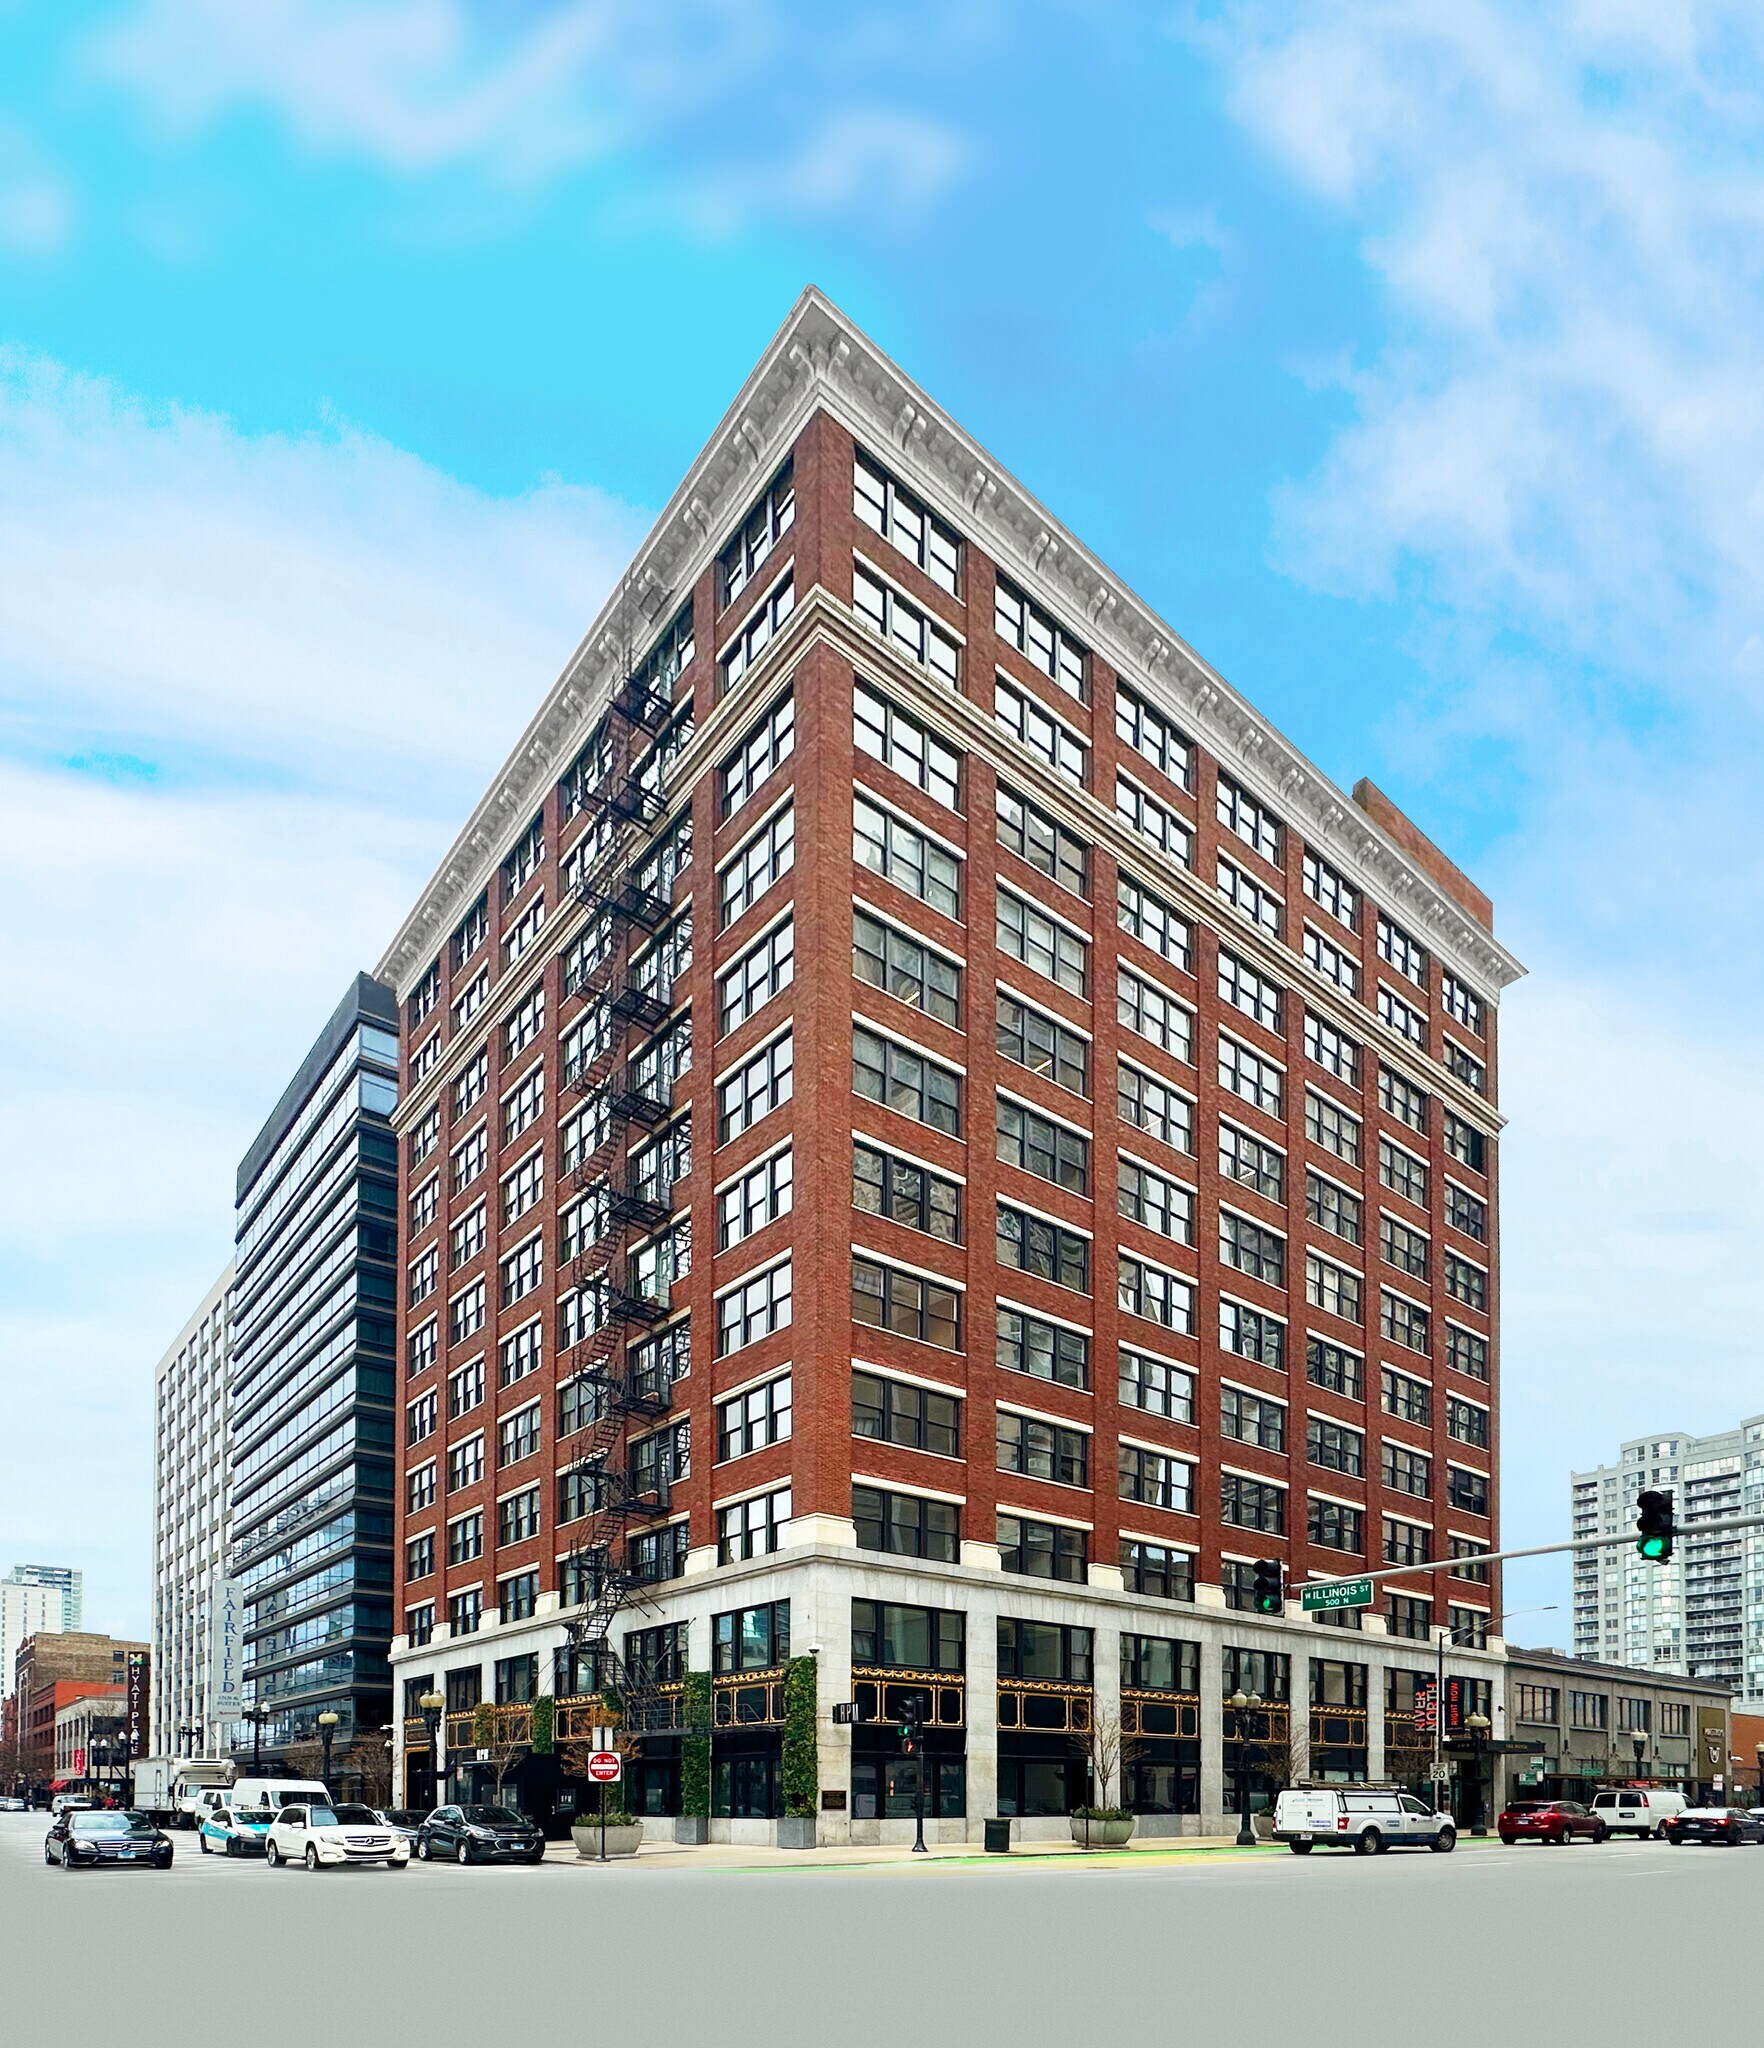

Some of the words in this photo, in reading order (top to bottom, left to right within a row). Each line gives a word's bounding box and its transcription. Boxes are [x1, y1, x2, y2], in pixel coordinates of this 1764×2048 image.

[1313, 1586, 1357, 1600] ILLINOIS
[1359, 1584, 1369, 1593] ST
[1325, 1598, 1340, 1606] 500
[222, 1586, 238, 1693] FAIRFIELD
[130, 1667, 141, 1709] HYATT
[1450, 1682, 1459, 1702] NOW
[840, 1703, 859, 1722] RPM
[1414, 1691, 1426, 1732] RIVER
[1426, 1683, 1437, 1731] NORTH
[1450, 1703, 1459, 1726] RIGHT
[130, 1712, 141, 1754] PLAE
[1433, 1770, 1445, 1779] 20
